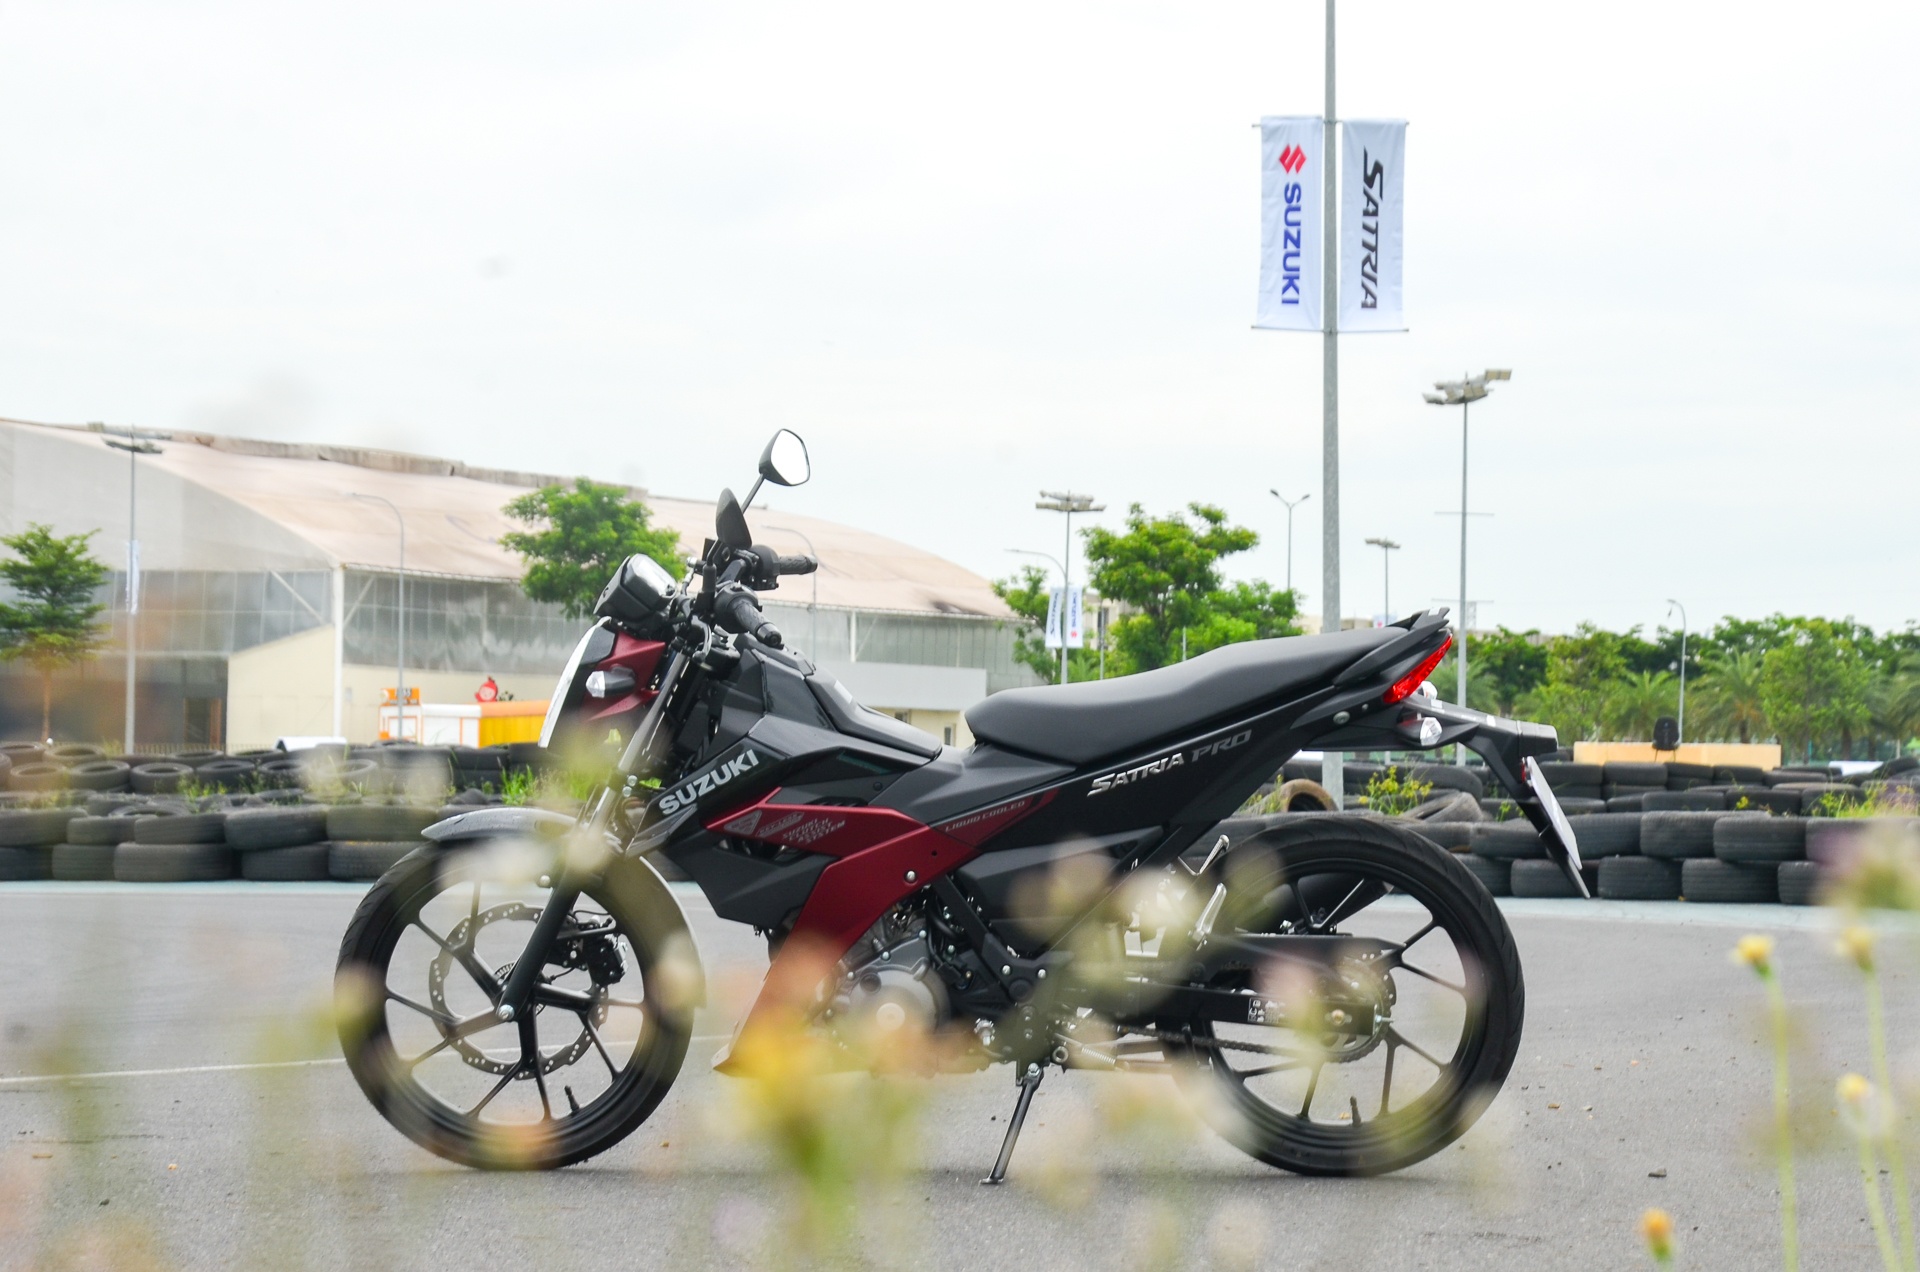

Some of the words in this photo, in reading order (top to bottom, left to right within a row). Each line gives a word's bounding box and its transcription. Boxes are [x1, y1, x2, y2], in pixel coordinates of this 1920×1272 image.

[1281, 182, 1302, 305] SUZUKI
[1361, 145, 1384, 309] SATRIA
[658, 749, 760, 816] SUZUKI
[1086, 752, 1185, 797] SATRIA
[1191, 729, 1253, 762] PRO
[783, 818, 818, 840] SUZUKI
[945, 815, 981, 833] LIQUID
[981, 800, 1025, 819] COOLED
